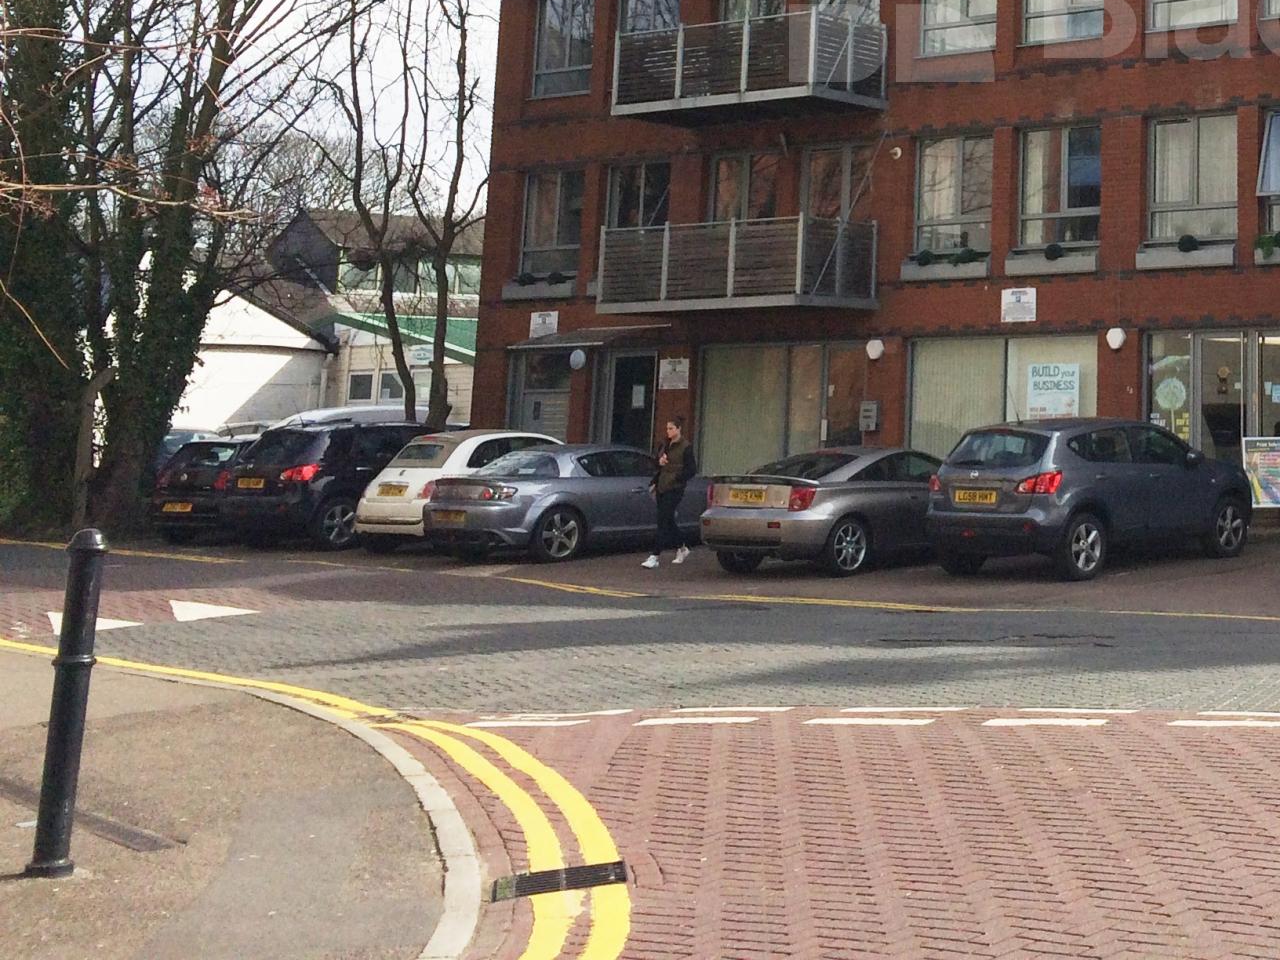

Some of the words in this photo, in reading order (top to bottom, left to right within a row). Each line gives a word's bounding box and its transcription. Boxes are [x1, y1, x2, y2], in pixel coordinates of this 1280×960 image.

[1031, 366, 1060, 377] BUILD
[1061, 370, 1075, 378] your
[1033, 380, 1075, 391] BUSINESS
